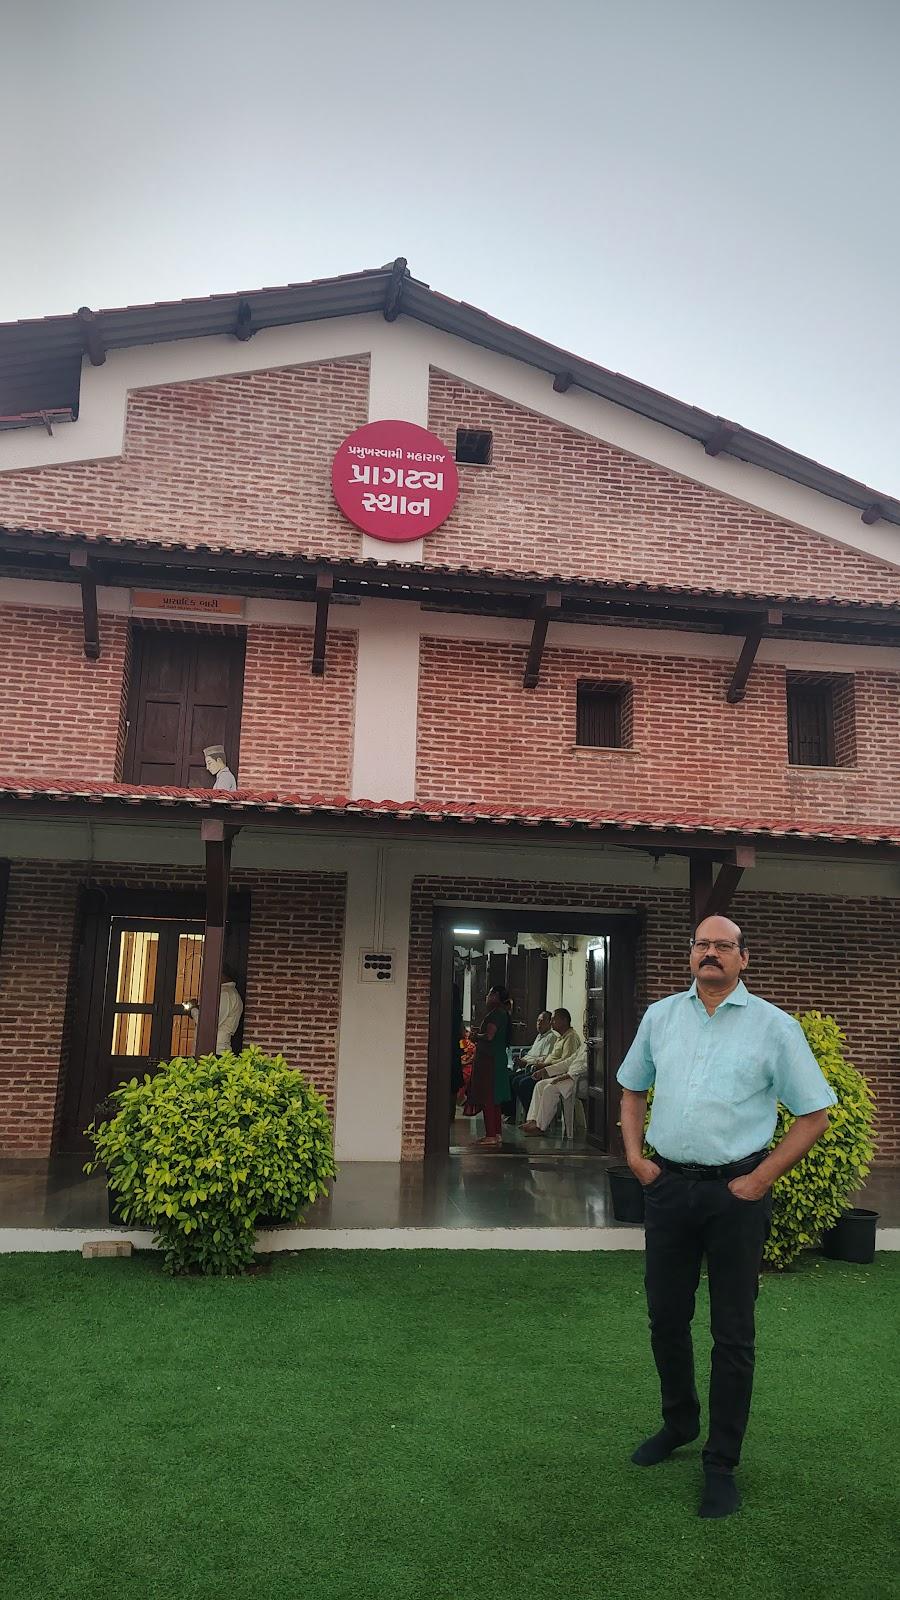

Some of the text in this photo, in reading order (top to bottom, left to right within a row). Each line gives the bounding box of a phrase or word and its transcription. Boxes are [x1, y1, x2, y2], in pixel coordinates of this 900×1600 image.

[347, 445, 445, 463] પ્રમુખસ્વામી મહારાજ
[348, 464, 444, 491] પ્રાગટ્ય
[361, 492, 430, 517] સ્થાન
